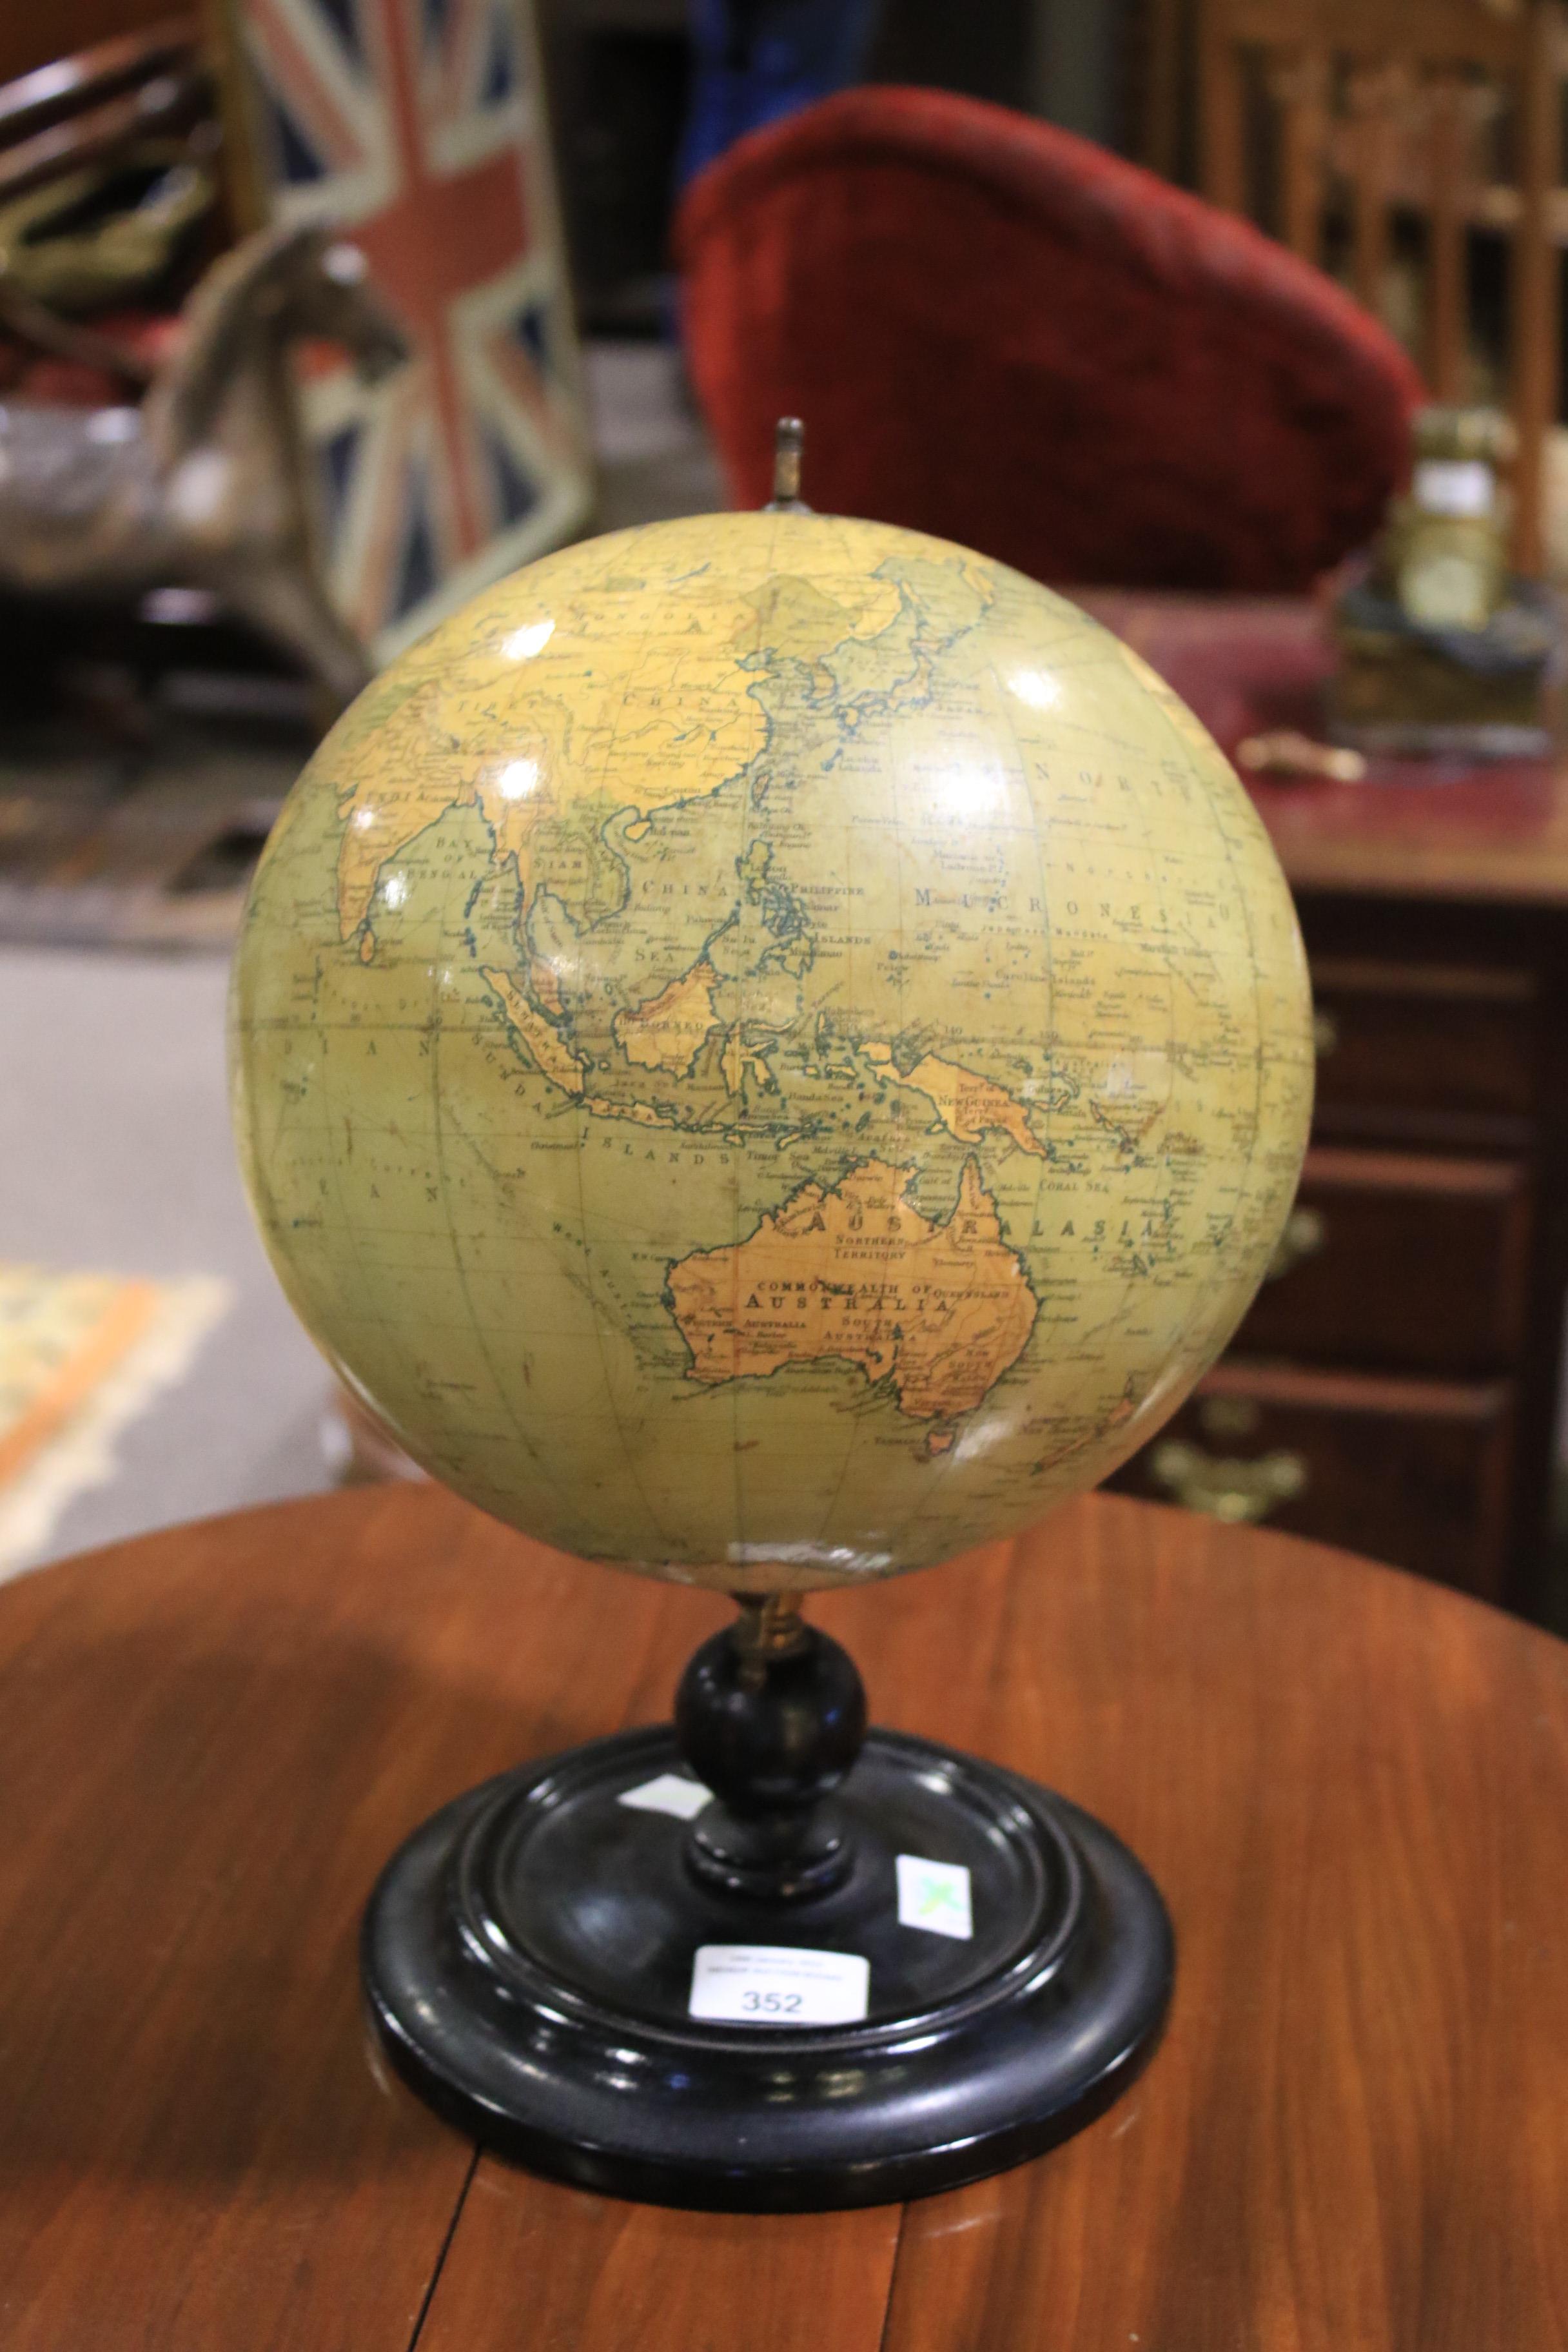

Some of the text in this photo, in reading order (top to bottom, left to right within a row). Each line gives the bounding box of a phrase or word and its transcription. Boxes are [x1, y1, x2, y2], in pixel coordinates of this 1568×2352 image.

[622, 694, 737, 707] CHINA
[642, 881, 729, 897] CHINA
[791, 883, 865, 896] PHILIPPINE
[814, 932, 872, 945] ISLANDS
[634, 948, 676, 963] SEA
[809, 1210, 1153, 1237] AUSTRALASIA
[836, 1234, 904, 1246] NORTHERN
[834, 1246, 906, 1259] TERRITORY
[912, 1284, 933, 1295] OF
[744, 1293, 949, 1311] AUSTRALIA
[741, 1990, 805, 2014] 352
